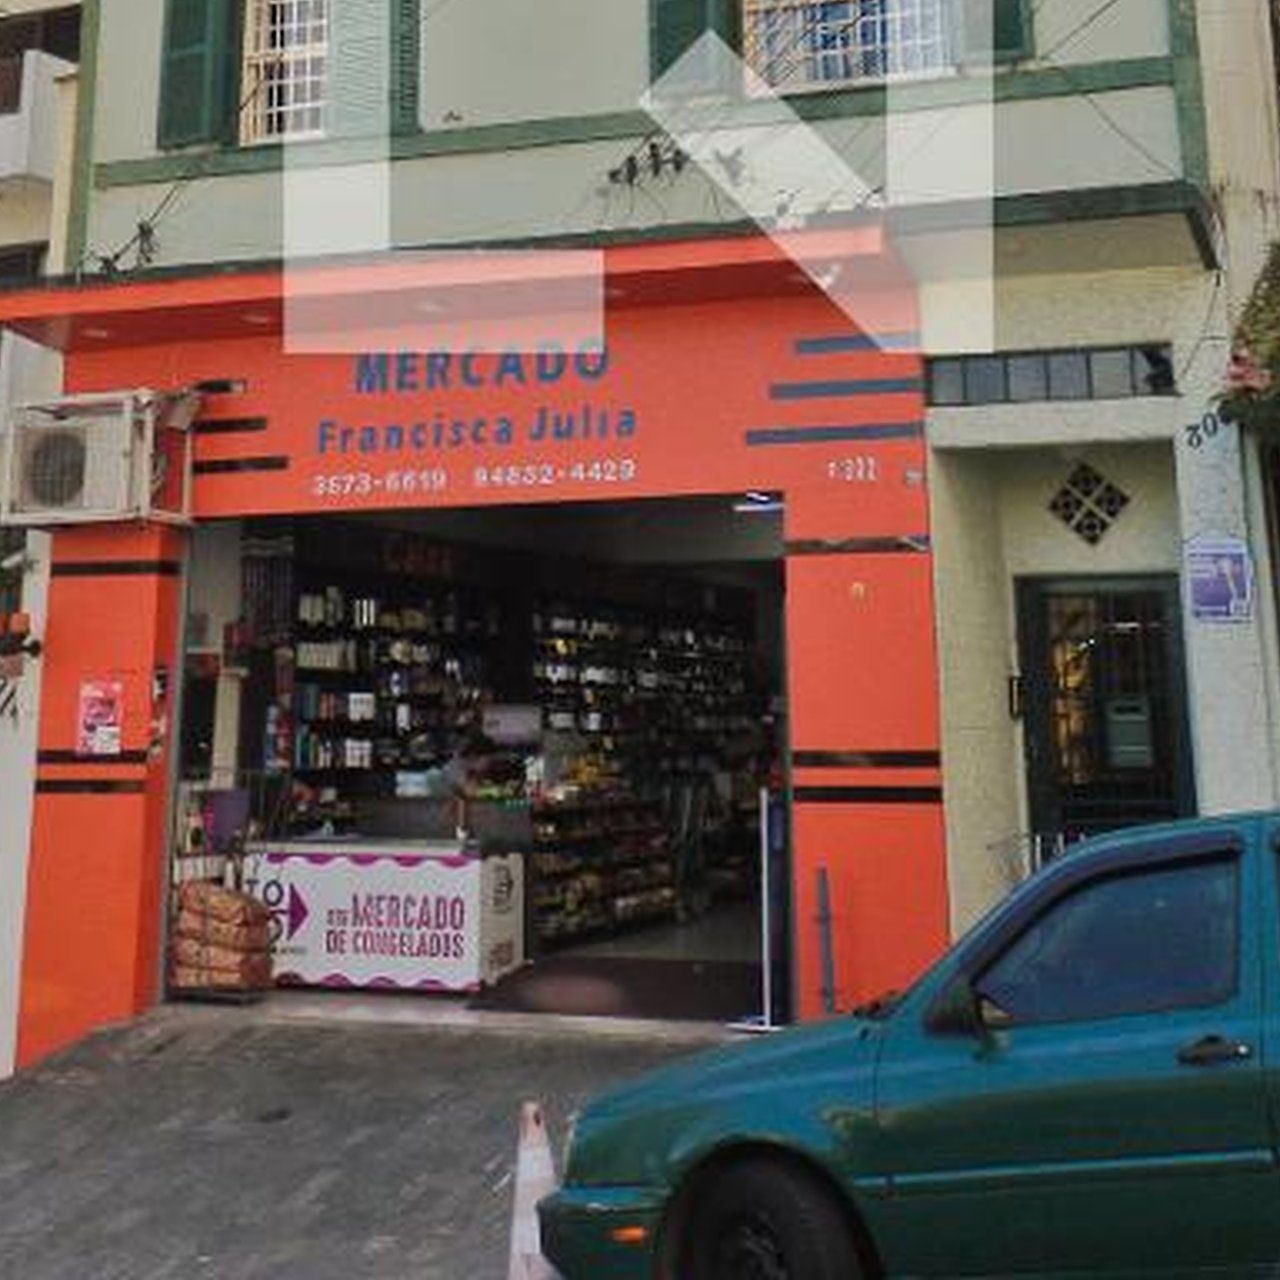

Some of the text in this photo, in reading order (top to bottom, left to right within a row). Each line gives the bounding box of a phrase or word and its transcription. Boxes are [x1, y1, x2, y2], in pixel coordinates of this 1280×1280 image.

[355, 338, 609, 393] MERCADO
[319, 413, 513, 454] Francisca
[351, 893, 465, 930] MERCADO
[325, 929, 347, 955] DE
